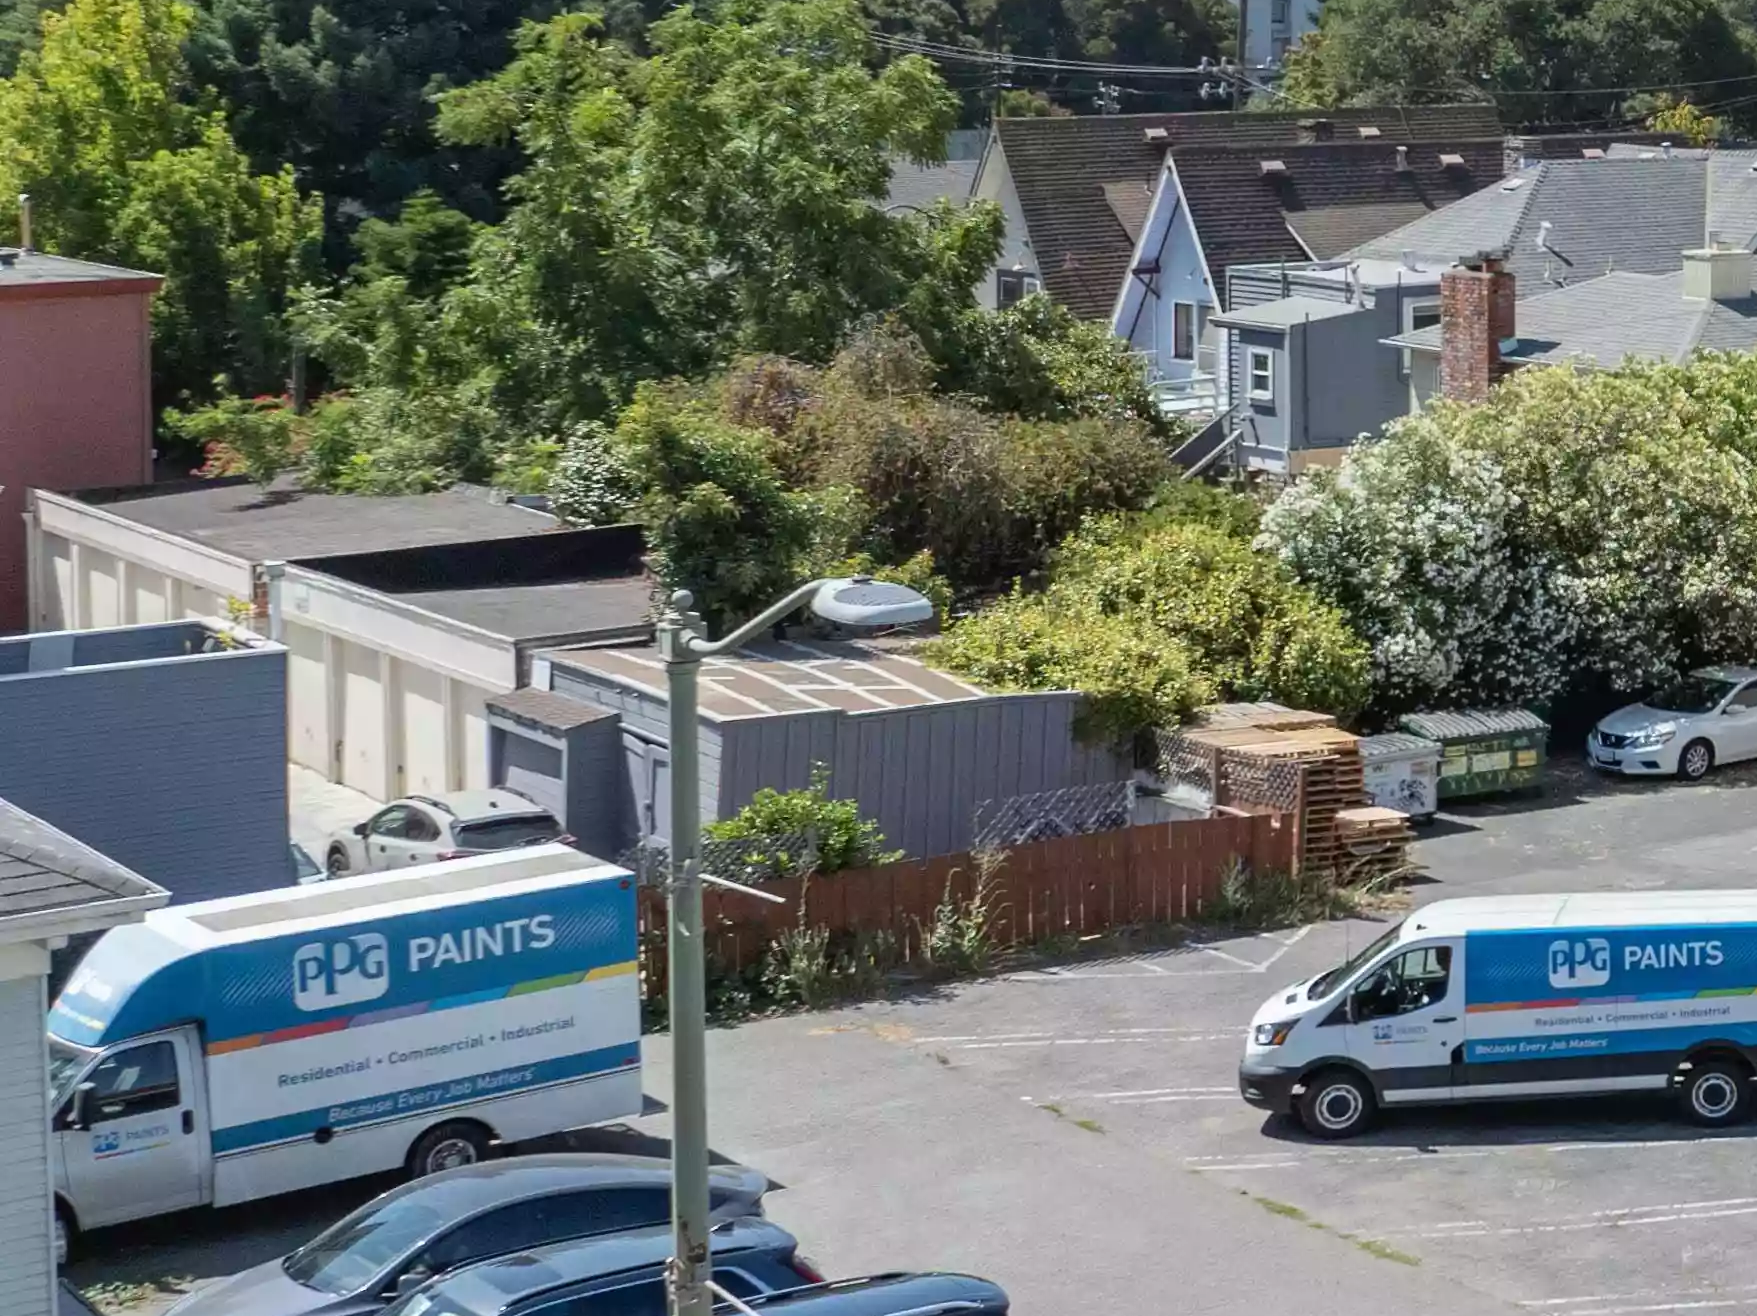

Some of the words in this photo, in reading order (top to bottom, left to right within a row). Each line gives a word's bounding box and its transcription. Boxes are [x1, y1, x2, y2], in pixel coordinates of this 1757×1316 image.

[297, 934, 387, 999] PPG
[407, 914, 556, 972] PAINTS
[1551, 938, 1608, 981] PPG
[1624, 940, 1724, 970] PAINTS
[1535, 1014, 1597, 1028] Residential
[1605, 1010, 1669, 1023] Commercial
[1680, 1005, 1731, 1018] Industrial
[278, 1057, 371, 1088] Residential
[388, 1034, 484, 1065] Commercial
[501, 1015, 576, 1042] Industrial
[1475, 1043, 1517, 1055] Because
[1519, 1041, 1547, 1054] Every
[1548, 1039, 1568, 1051] Job
[1569, 1037, 1608, 1049] Matters
[328, 1099, 394, 1122] Because
[397, 1087, 443, 1109] Every
[444, 1081, 473, 1099] Job
[476, 1067, 534, 1091] Matters
